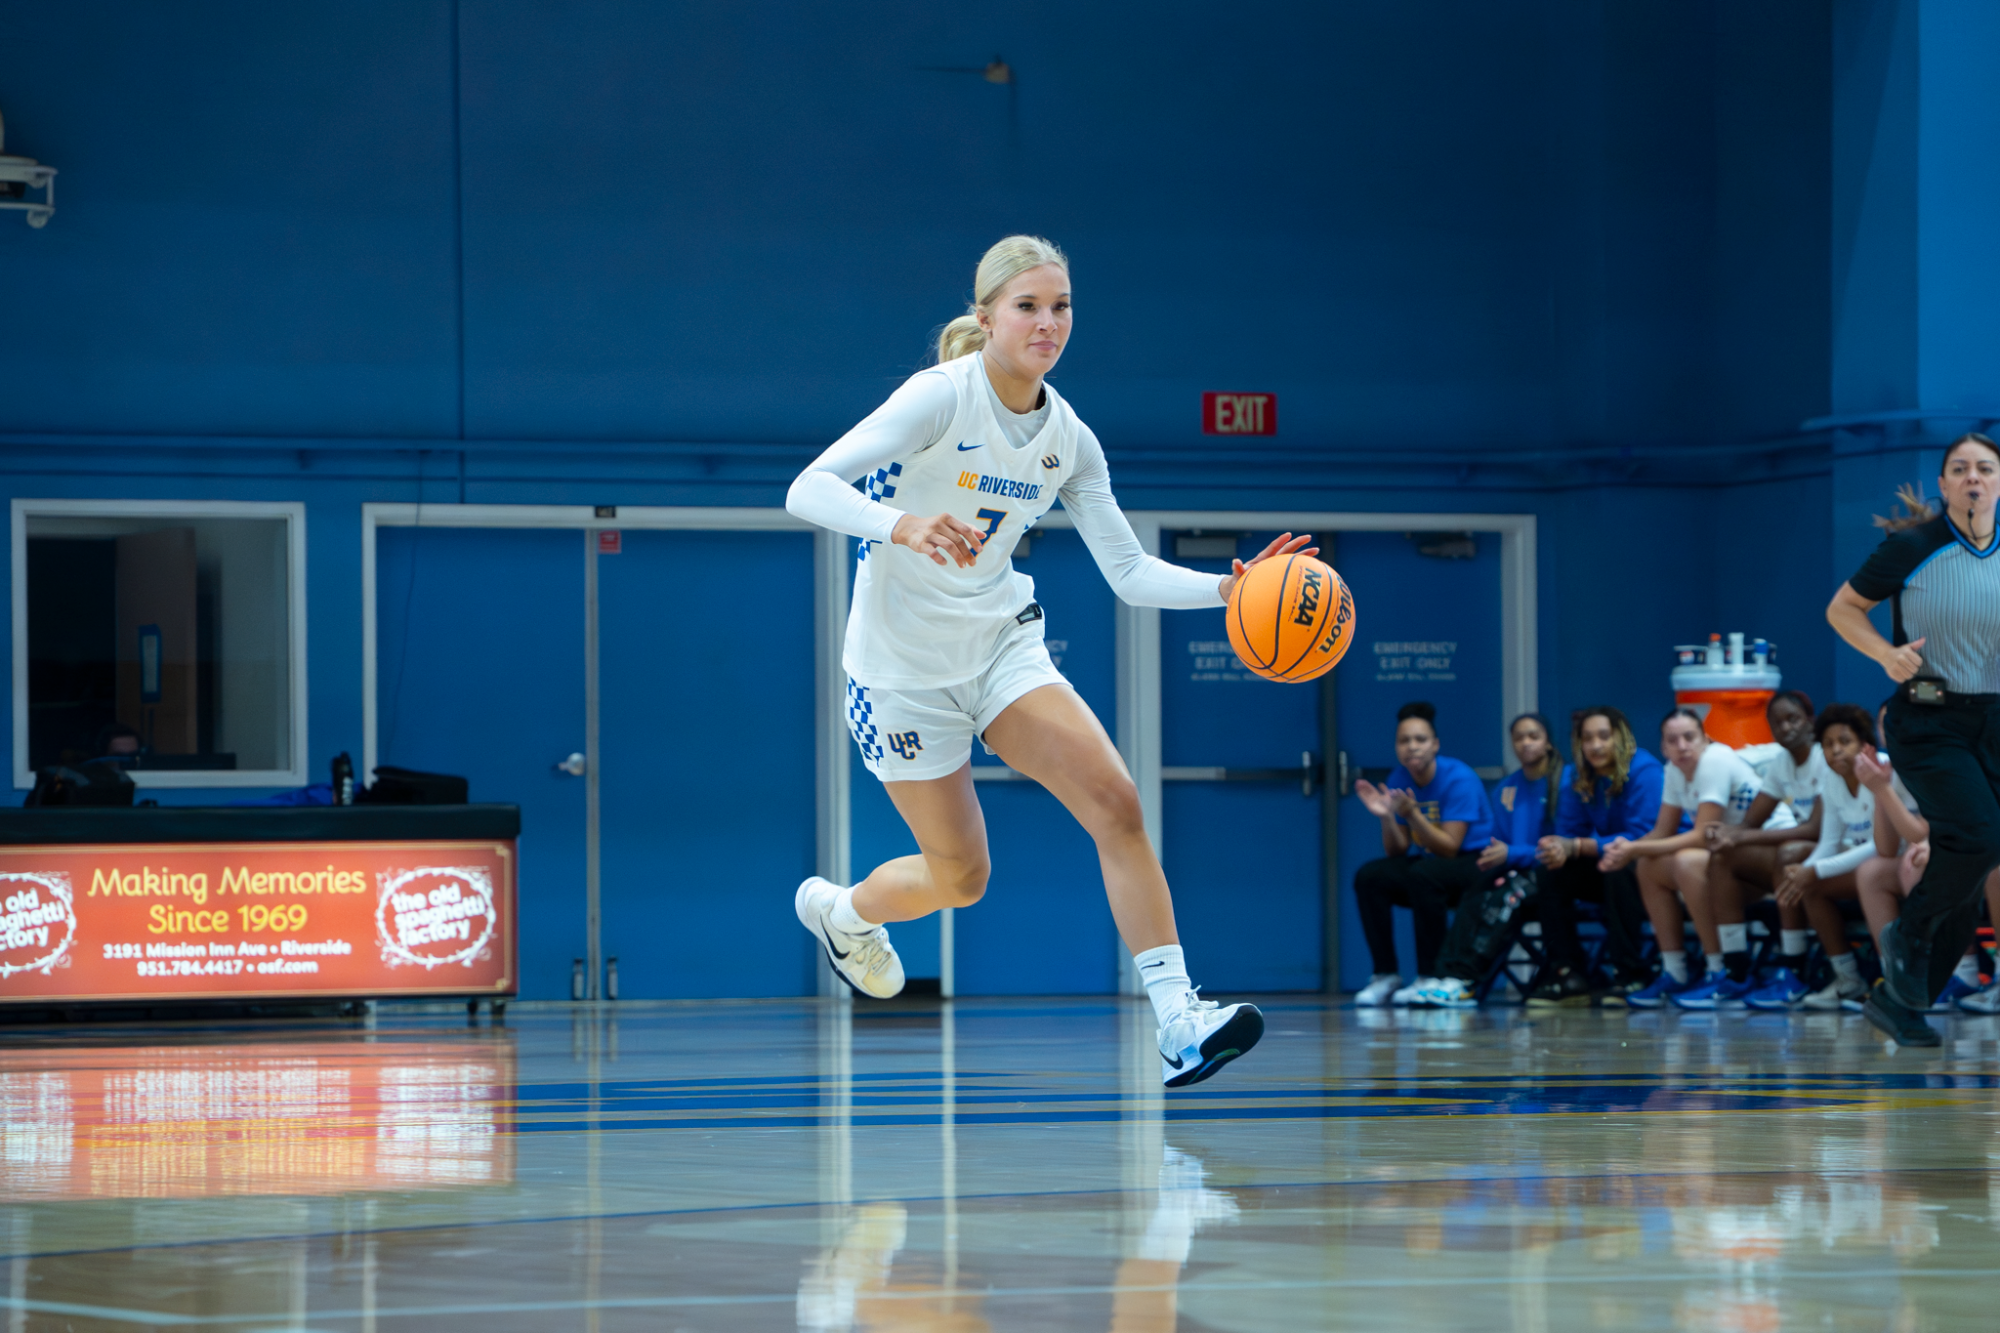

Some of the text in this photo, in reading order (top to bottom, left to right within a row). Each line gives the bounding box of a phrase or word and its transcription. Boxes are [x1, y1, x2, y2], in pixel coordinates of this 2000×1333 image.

[1215, 396, 1268, 432] EXIT
[957, 470, 979, 490] UC
[968, 507, 1008, 558] 7
[1293, 567, 1322, 627] NCAA
[5, 887, 39, 912] old
[87, 865, 367, 905] Making Memories
[391, 882, 461, 914] the old
[147, 903, 308, 934] Since 1969
[395, 895, 486, 930] spaghetti
[103, 939, 352, 959] 3191 Mission Inn Ave Riverside
[398, 919, 470, 948] factory
[137, 958, 319, 976] 951.784.4417 osf.com
